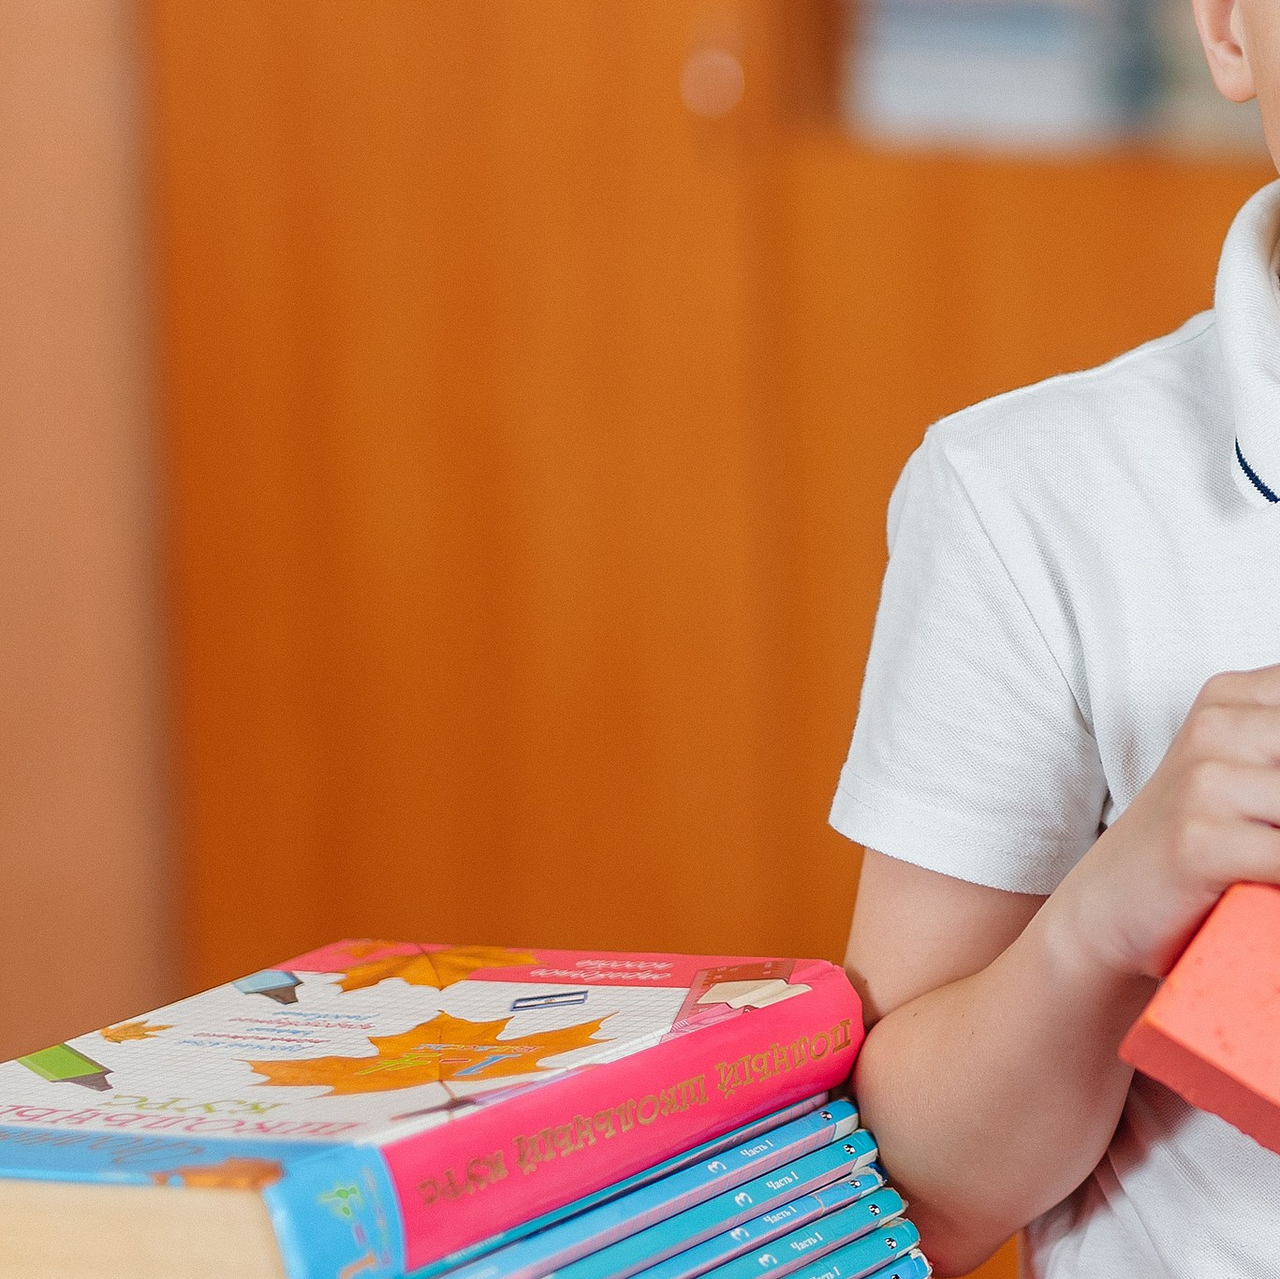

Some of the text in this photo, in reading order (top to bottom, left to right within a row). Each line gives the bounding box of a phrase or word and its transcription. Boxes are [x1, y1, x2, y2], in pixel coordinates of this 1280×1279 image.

[418, 1019, 852, 1206] ПОЛНЫЙ ШКОЛЬНЫЙ КУРС
[740, 1144, 767, 1158] Часть
[767, 1139, 774, 1149] 1
[766, 1175, 794, 1190] Часть
[793, 1170, 799, 1181] 1
[763, 1209, 791, 1224] Часть
[790, 1205, 797, 1214] 1
[790, 1236, 818, 1252] Часть
[817, 1232, 824, 1241] 1
[834, 1266, 840, 1276] 1
